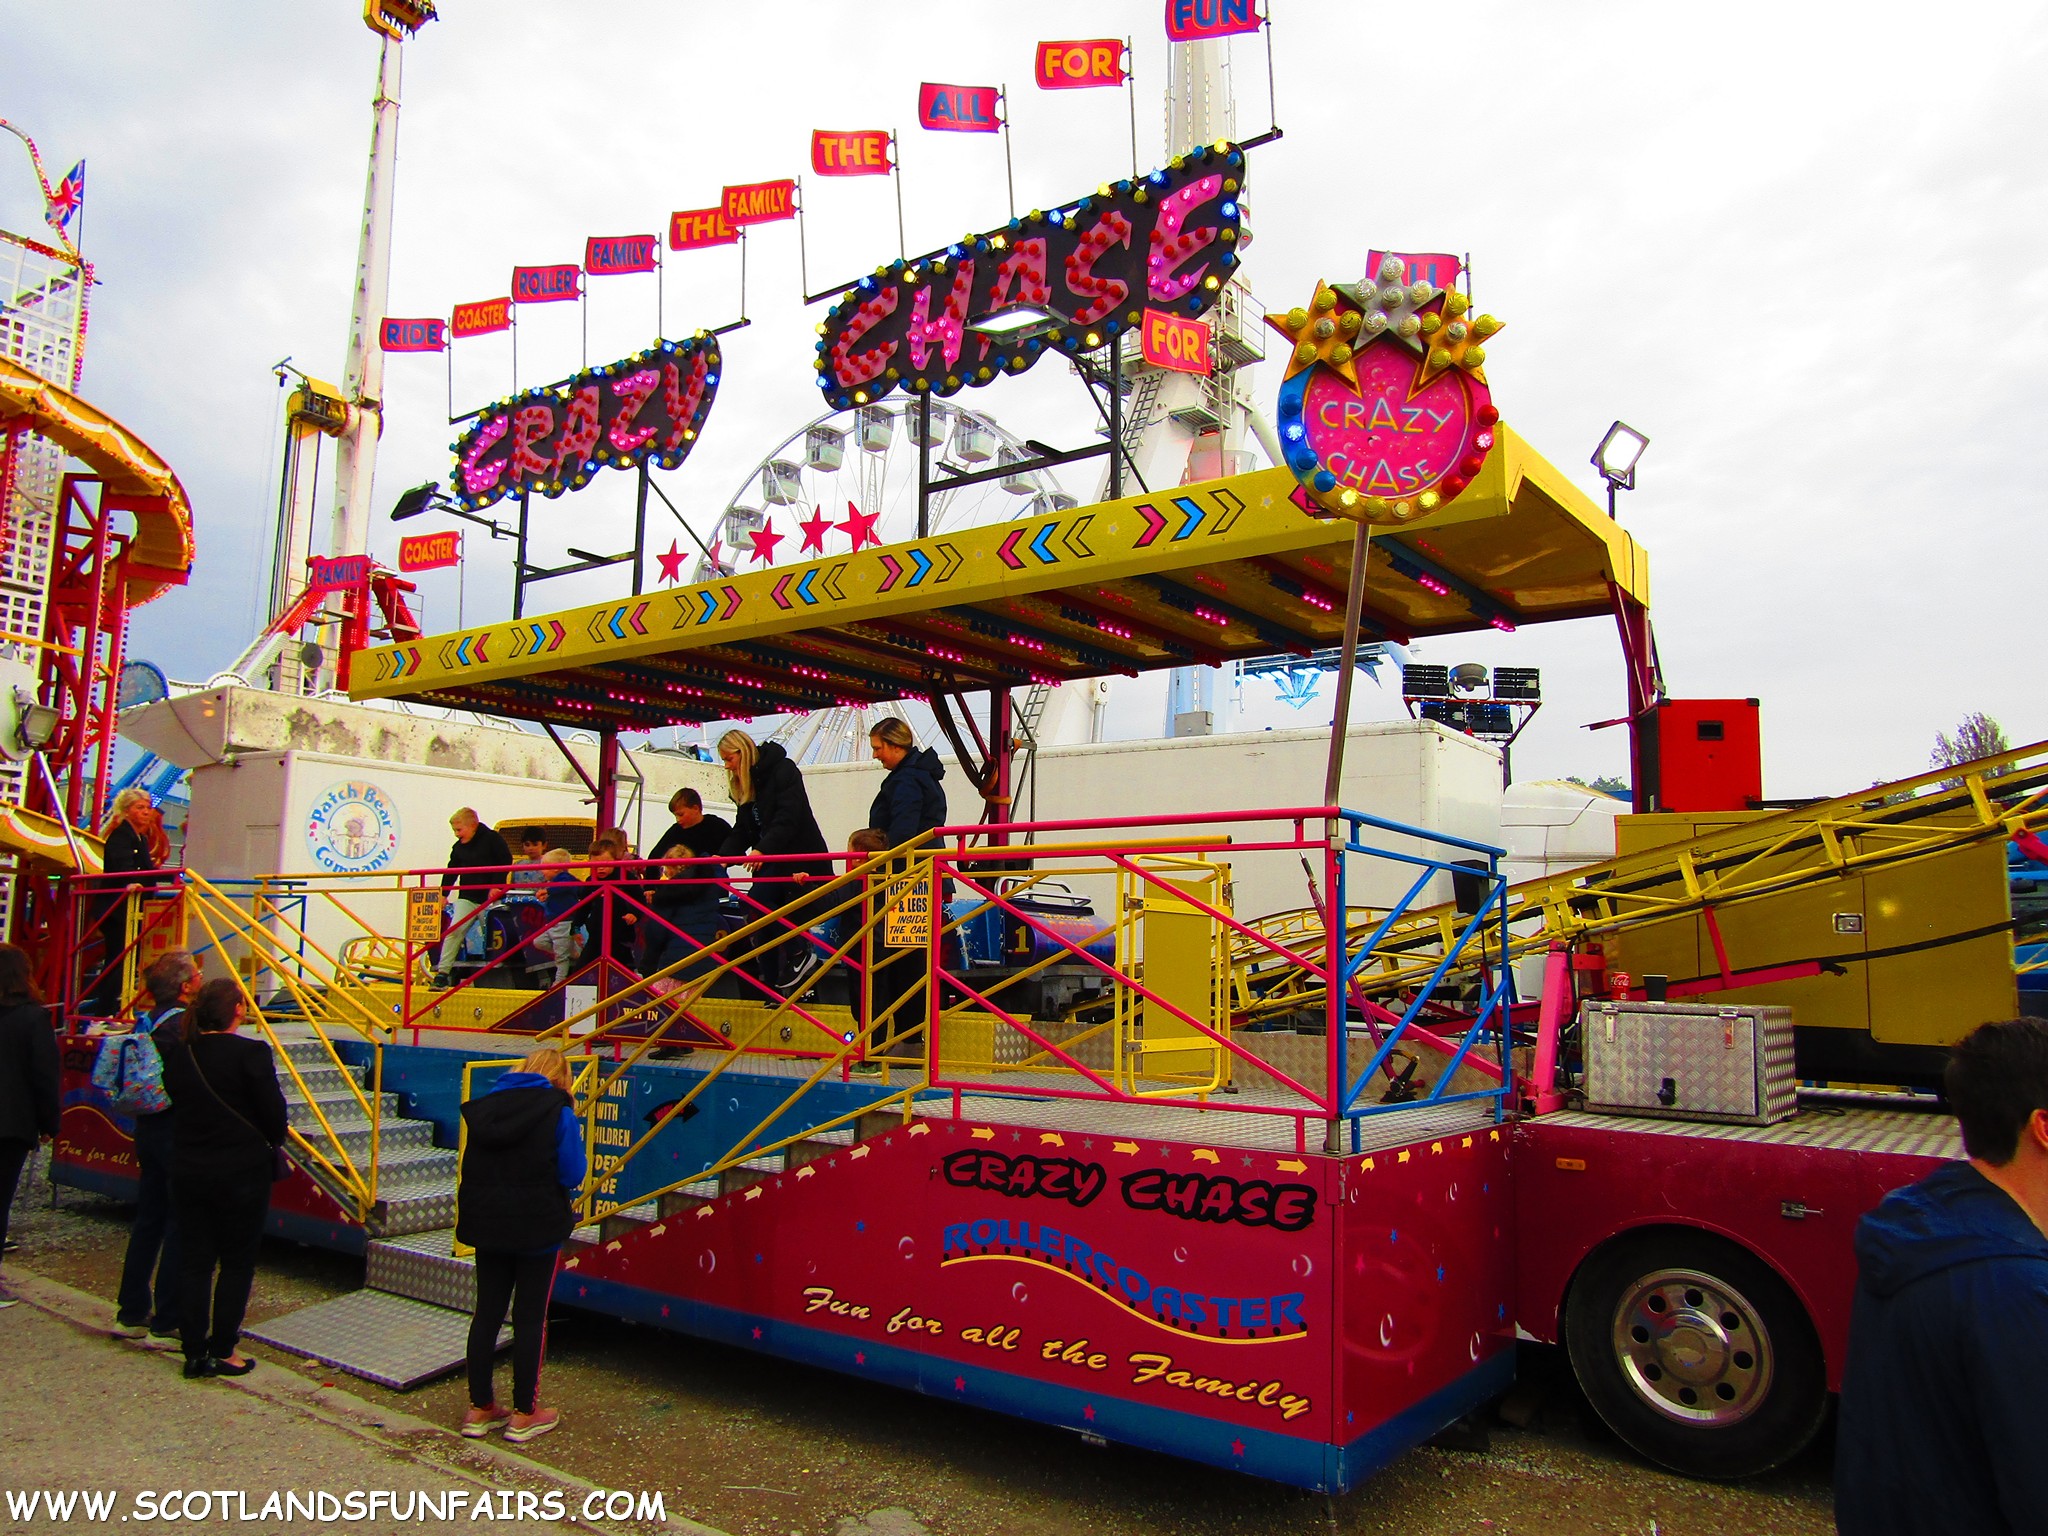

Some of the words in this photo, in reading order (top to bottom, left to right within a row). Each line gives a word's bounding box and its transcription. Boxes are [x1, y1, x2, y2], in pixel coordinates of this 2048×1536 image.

[1172, 0, 1248, 32] FUN
[1044, 47, 1114, 78] FOR
[927, 91, 988, 124] ALL
[819, 137, 880, 165] THE
[728, 186, 787, 218] FAMILY
[592, 241, 648, 268] FAMILY
[518, 270, 573, 296] ROLLER
[834, 174, 1222, 388] CHASE
[456, 305, 505, 330] COASTER
[385, 323, 439, 345] RIDE
[1152, 325, 1200, 365] FOR
[463, 350, 706, 493] CRAZY
[1320, 397, 1454, 434] CRAZY
[1325, 452, 1438, 494] CHASE
[404, 538, 453, 564] COASTER
[317, 561, 361, 585] FAMILY
[311, 784, 358, 823] Patch
[364, 786, 393, 828] Bear
[912, 881, 928, 895] ARM
[899, 900, 904, 912] &
[908, 898, 927, 912] LEGS
[890, 926, 906, 934] THE
[910, 926, 928, 934] CAR
[897, 915, 928, 924] INSIDE
[493, 930, 503, 950] 5
[1014, 925, 1029, 953] 1
[647, 1010, 659, 1021] IN
[608, 1078, 628, 1098] MAY
[597, 1102, 619, 1121] WITH
[594, 1125, 630, 1147] HILDREN
[59, 1140, 82, 1155] Fun
[87, 1147, 105, 1161] for
[111, 1152, 130, 1165] all
[601, 1178, 617, 1194] BE
[943, 1150, 1105, 1206] CRAZY
[1122, 1169, 1316, 1230] CHASE
[942, 1219, 1305, 1328] ROLLERCOASTER
[802, 1287, 872, 1323] Fun
[886, 1307, 944, 1336] for
[960, 1324, 1021, 1352] all
[1040, 1338, 1108, 1372] the
[1128, 1353, 1312, 1421] Family
